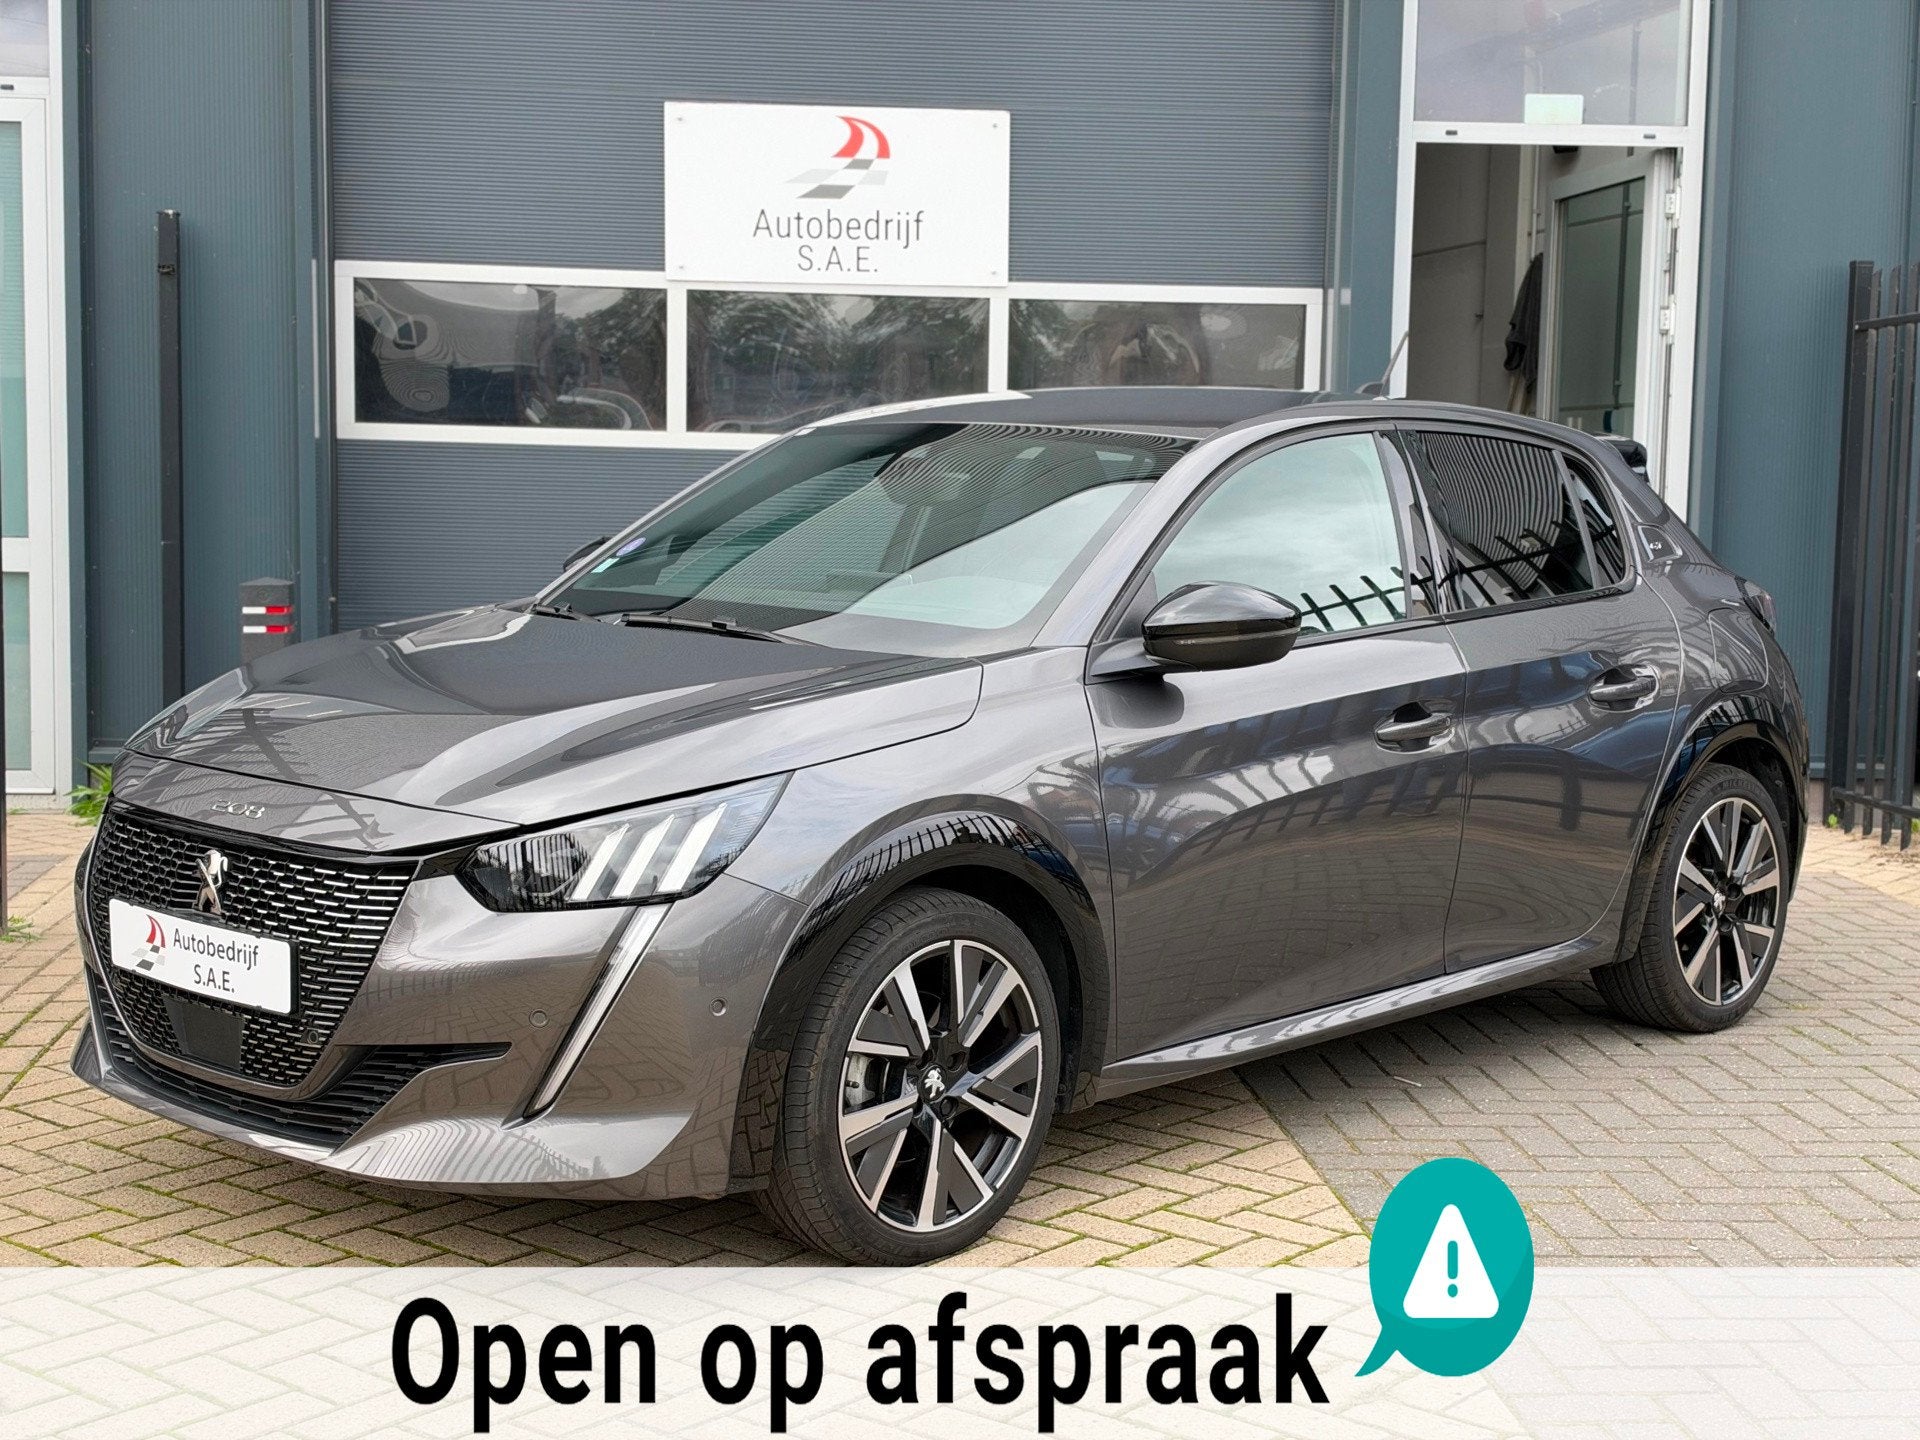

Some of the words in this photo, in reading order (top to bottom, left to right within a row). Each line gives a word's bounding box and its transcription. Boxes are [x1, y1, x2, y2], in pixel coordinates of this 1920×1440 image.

[753, 209, 924, 249] Autobedrijf
[797, 245, 878, 273] S.A.E.
[211, 799, 266, 820] 208
[173, 928, 260, 971] Autobedrijf
[194, 965, 236, 993] S.A.E.
